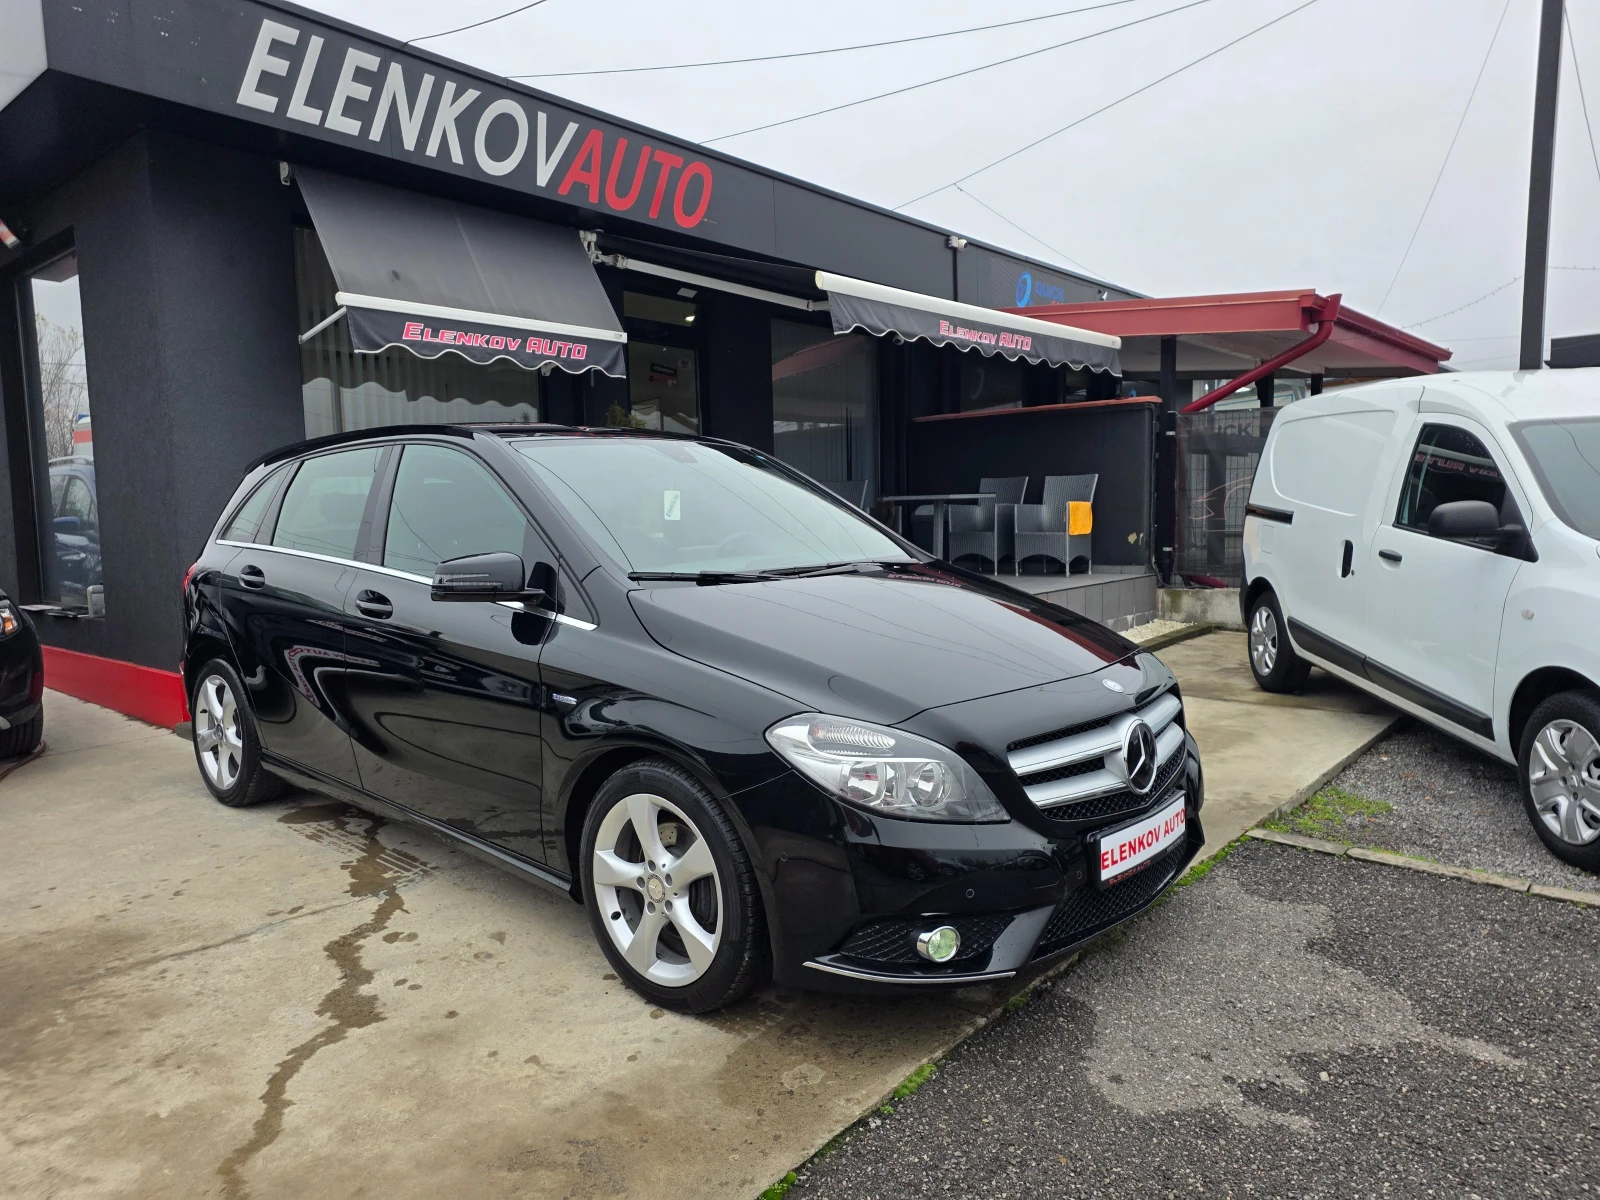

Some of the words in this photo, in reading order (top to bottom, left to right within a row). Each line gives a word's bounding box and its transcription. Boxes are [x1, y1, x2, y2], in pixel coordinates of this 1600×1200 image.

[1035, 281, 1065, 302] QUICK
[402, 321, 521, 351] ELENKOV
[525, 337, 587, 360] AUTO
[939, 319, 997, 345] ELENKOV
[998, 332, 1032, 351] AUTO
[1101, 825, 1161, 871] ELENKOV
[1163, 808, 1186, 838] AUTO
